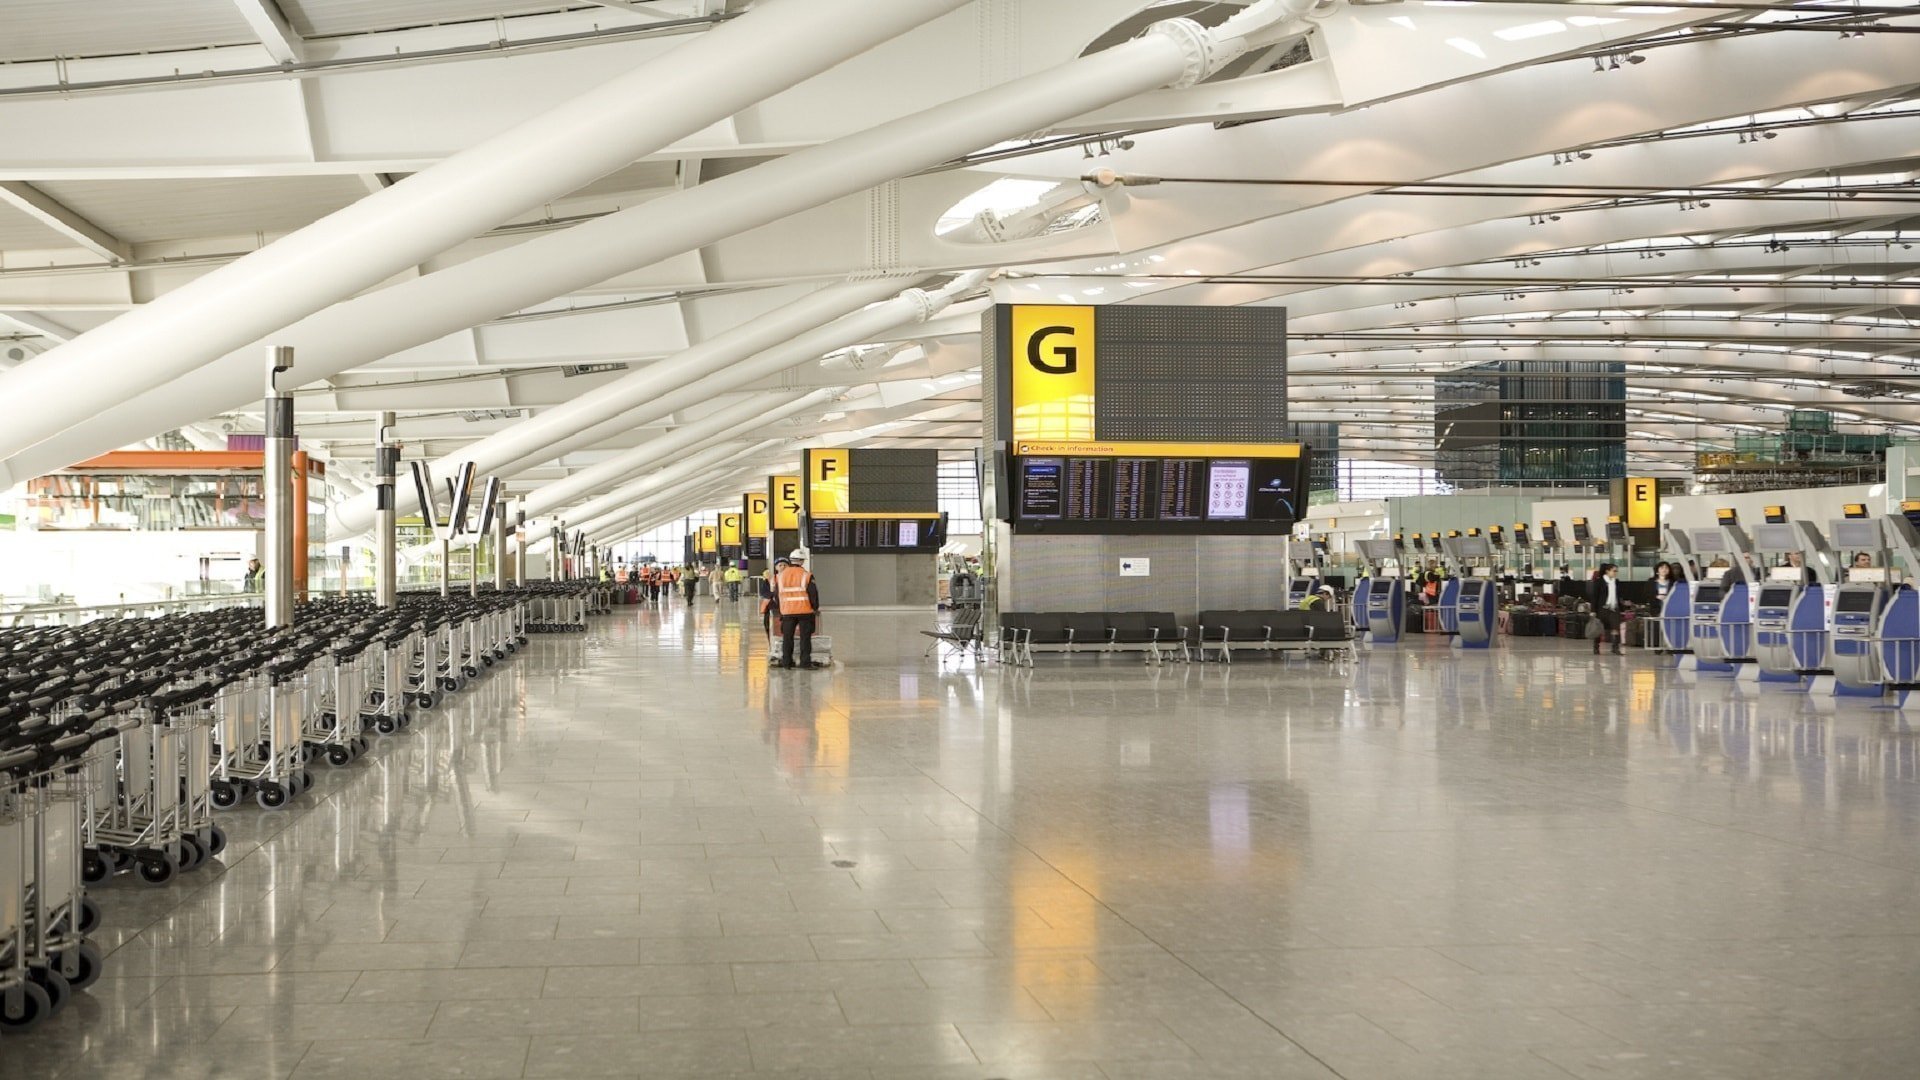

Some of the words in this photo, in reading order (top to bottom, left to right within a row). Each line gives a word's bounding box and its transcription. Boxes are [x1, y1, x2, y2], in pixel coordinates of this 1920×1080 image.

[1027, 325, 1078, 375] G
[1067, 445, 1114, 453] information
[821, 459, 837, 481] F
[783, 483, 796, 501] E
[1635, 484, 1648, 502] E
[753, 499, 767, 514] D
[725, 517, 736, 527] C
[705, 530, 712, 538] B
